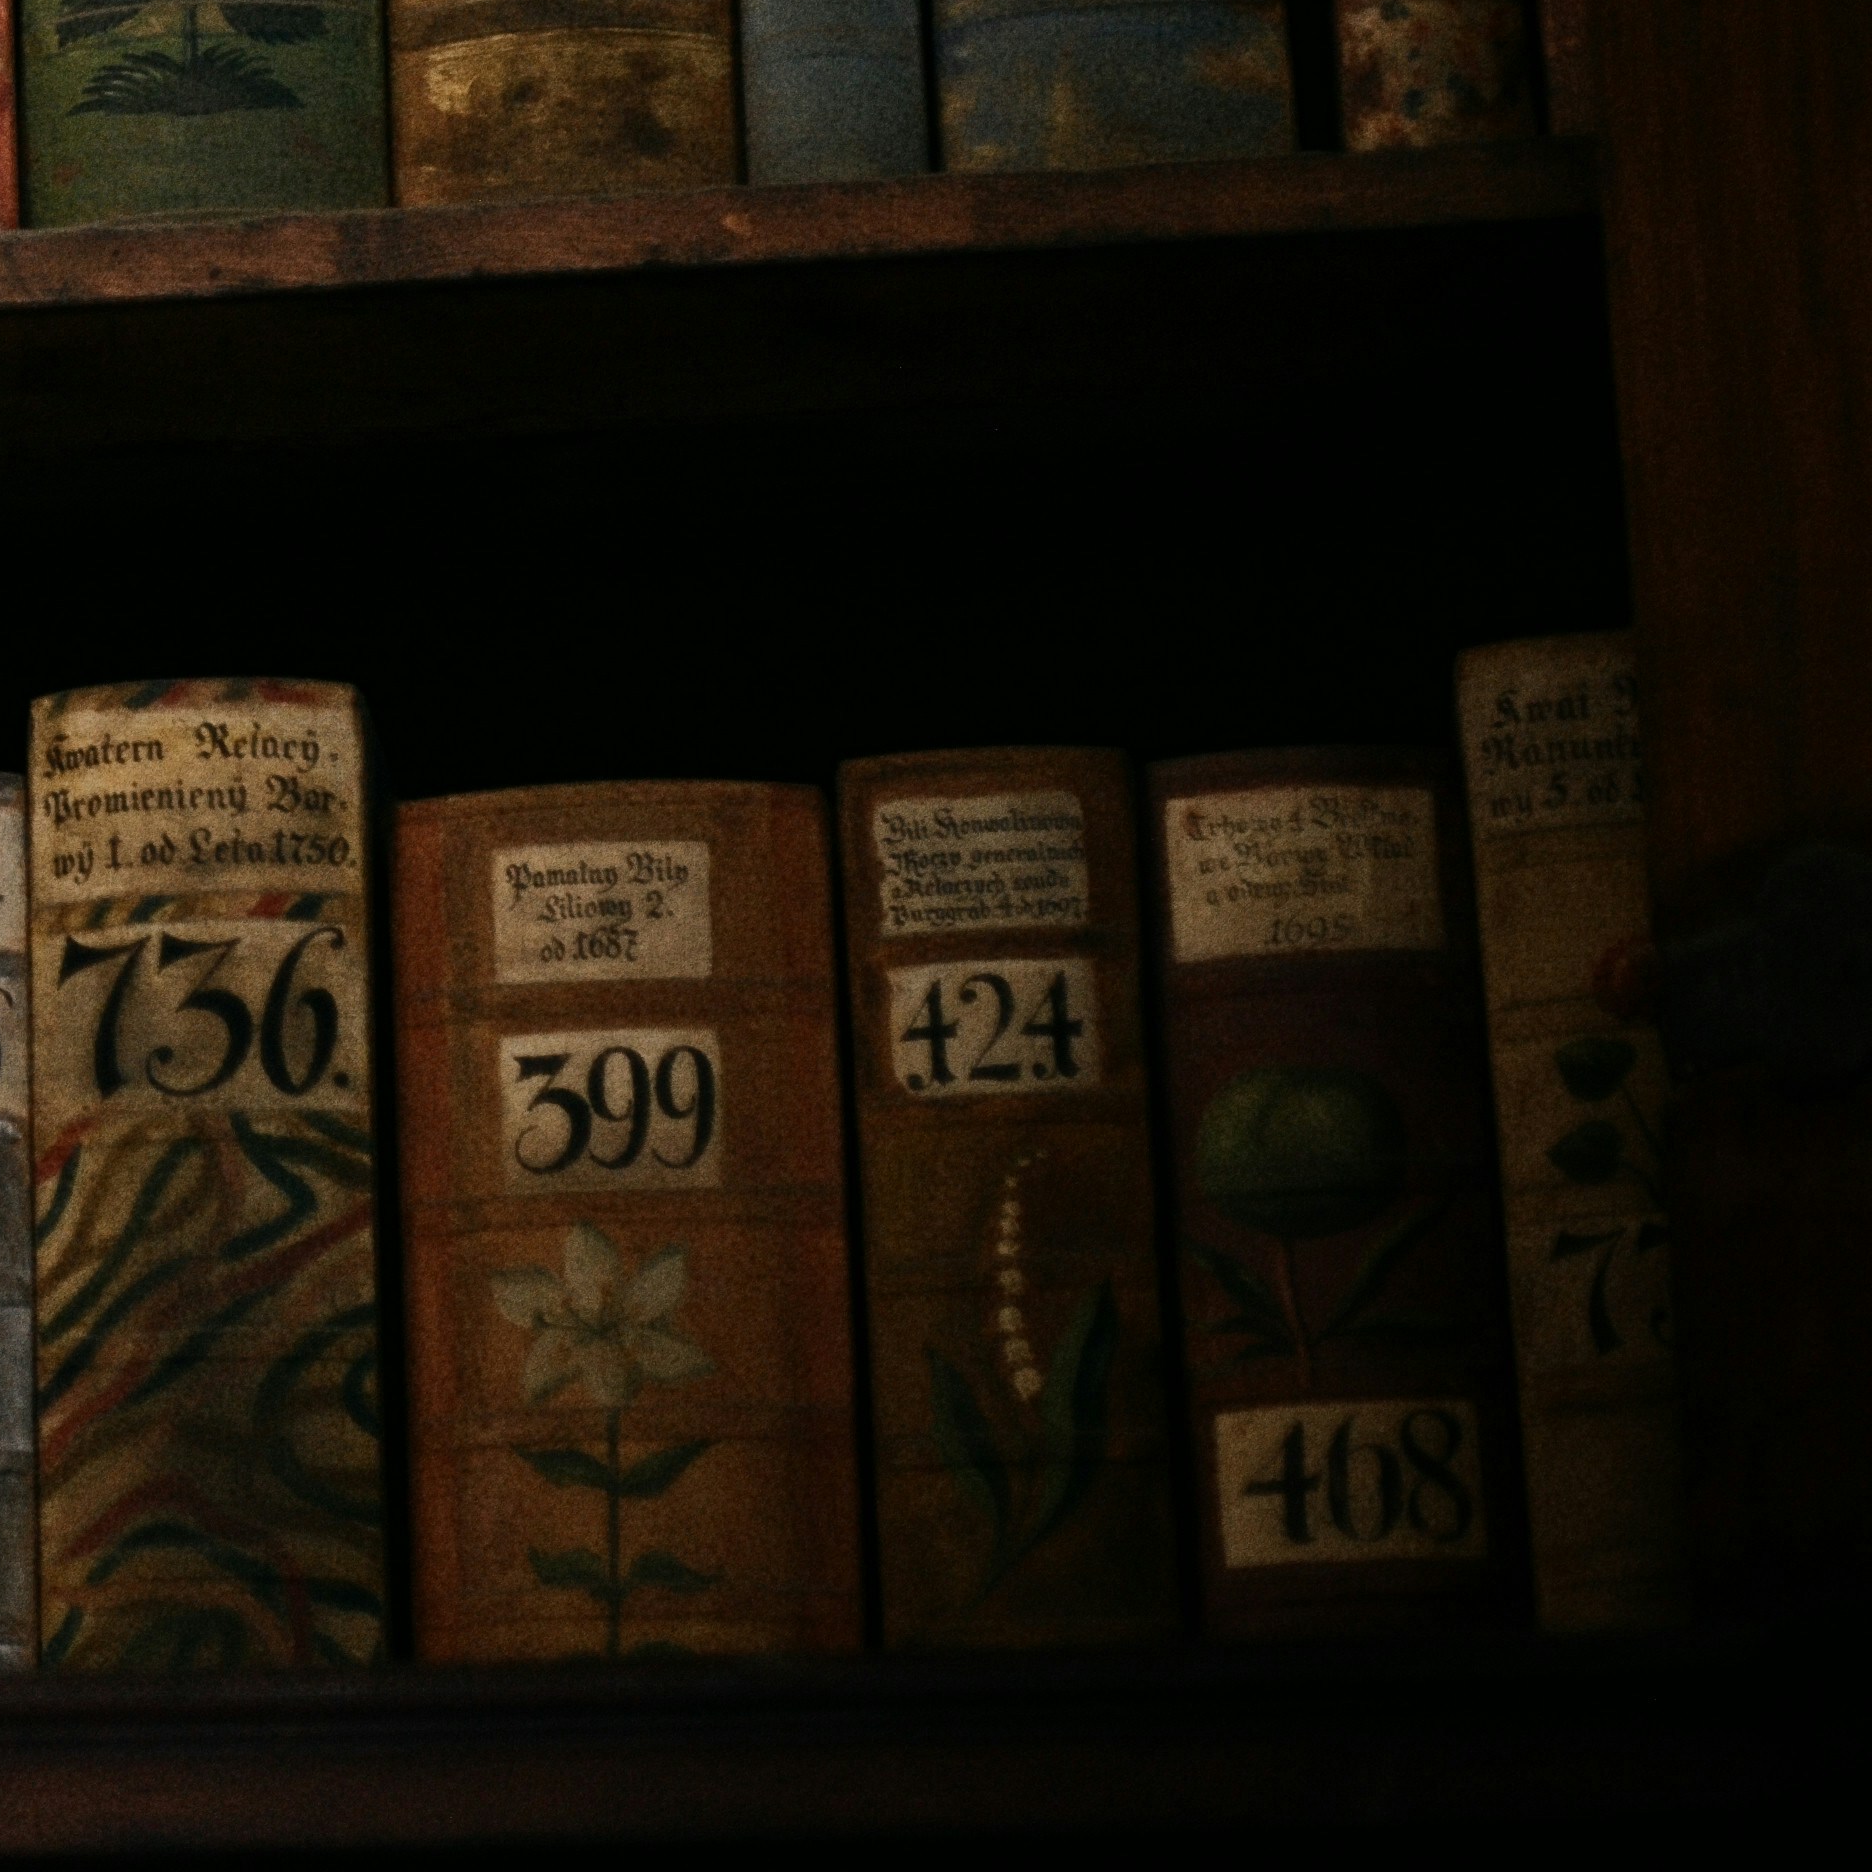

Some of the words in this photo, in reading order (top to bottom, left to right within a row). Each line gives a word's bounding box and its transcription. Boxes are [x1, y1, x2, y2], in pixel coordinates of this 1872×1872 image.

[55, 925, 352, 1101] 736.
[901, 971, 1084, 1091] 424
[513, 1044, 717, 1177] 399
